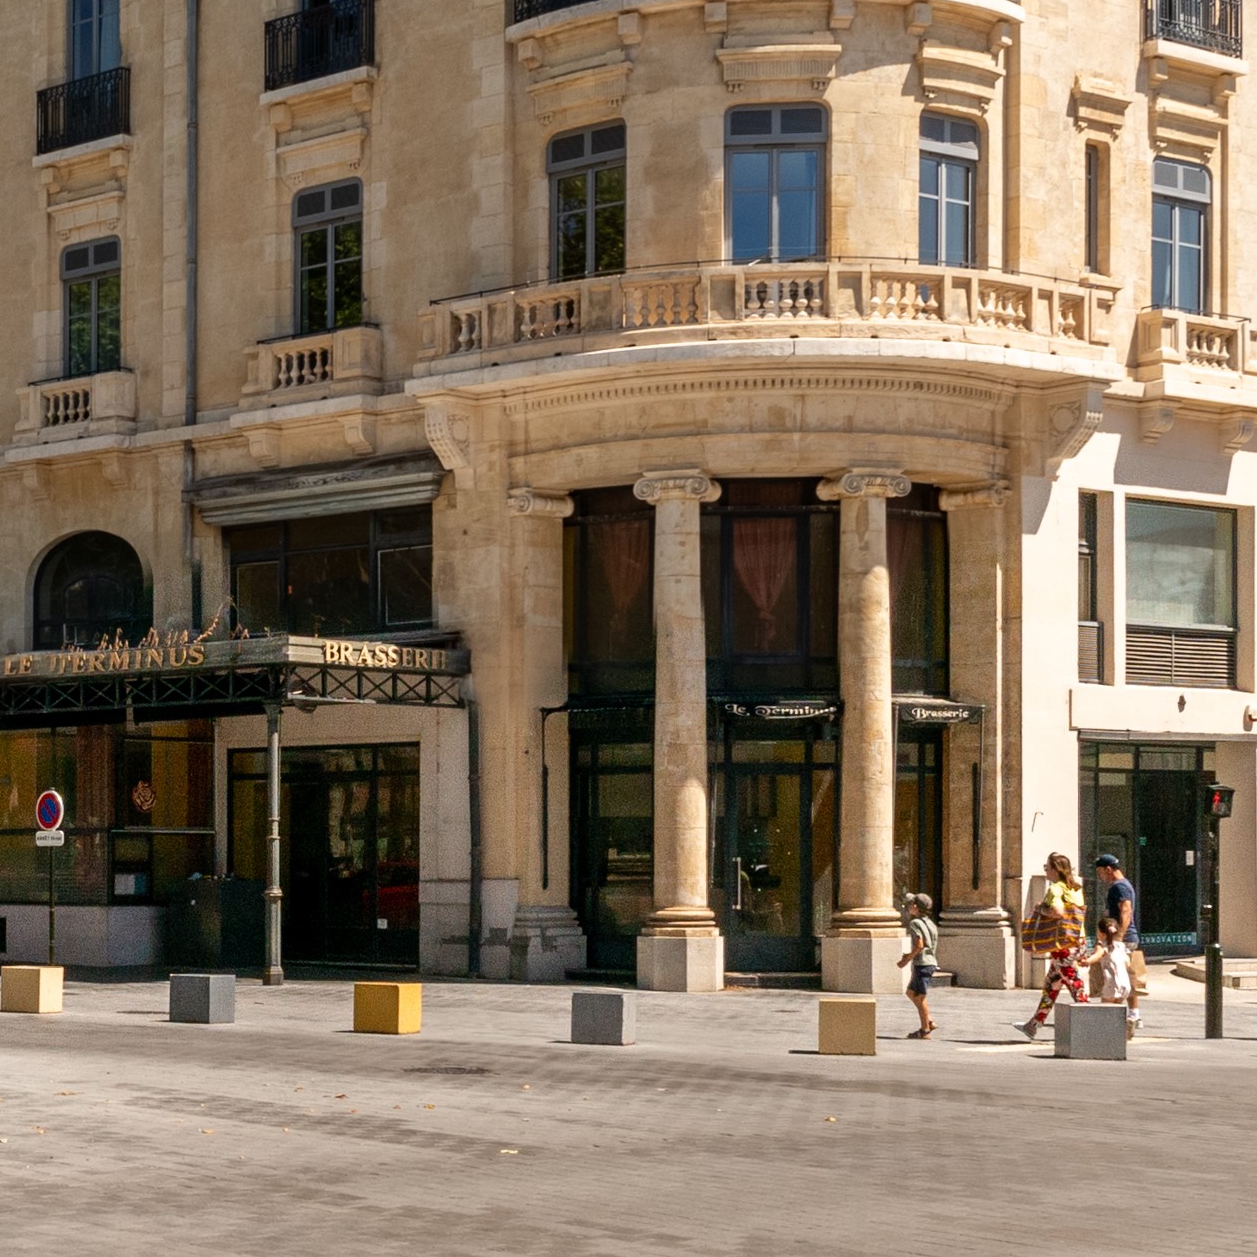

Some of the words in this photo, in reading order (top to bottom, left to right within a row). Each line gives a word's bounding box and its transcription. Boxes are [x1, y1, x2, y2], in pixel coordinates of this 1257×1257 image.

[4, 654, 33, 676] LE
[912, 707, 969, 719] Brasserie
[1140, 934, 1192, 944] INNOVATION
